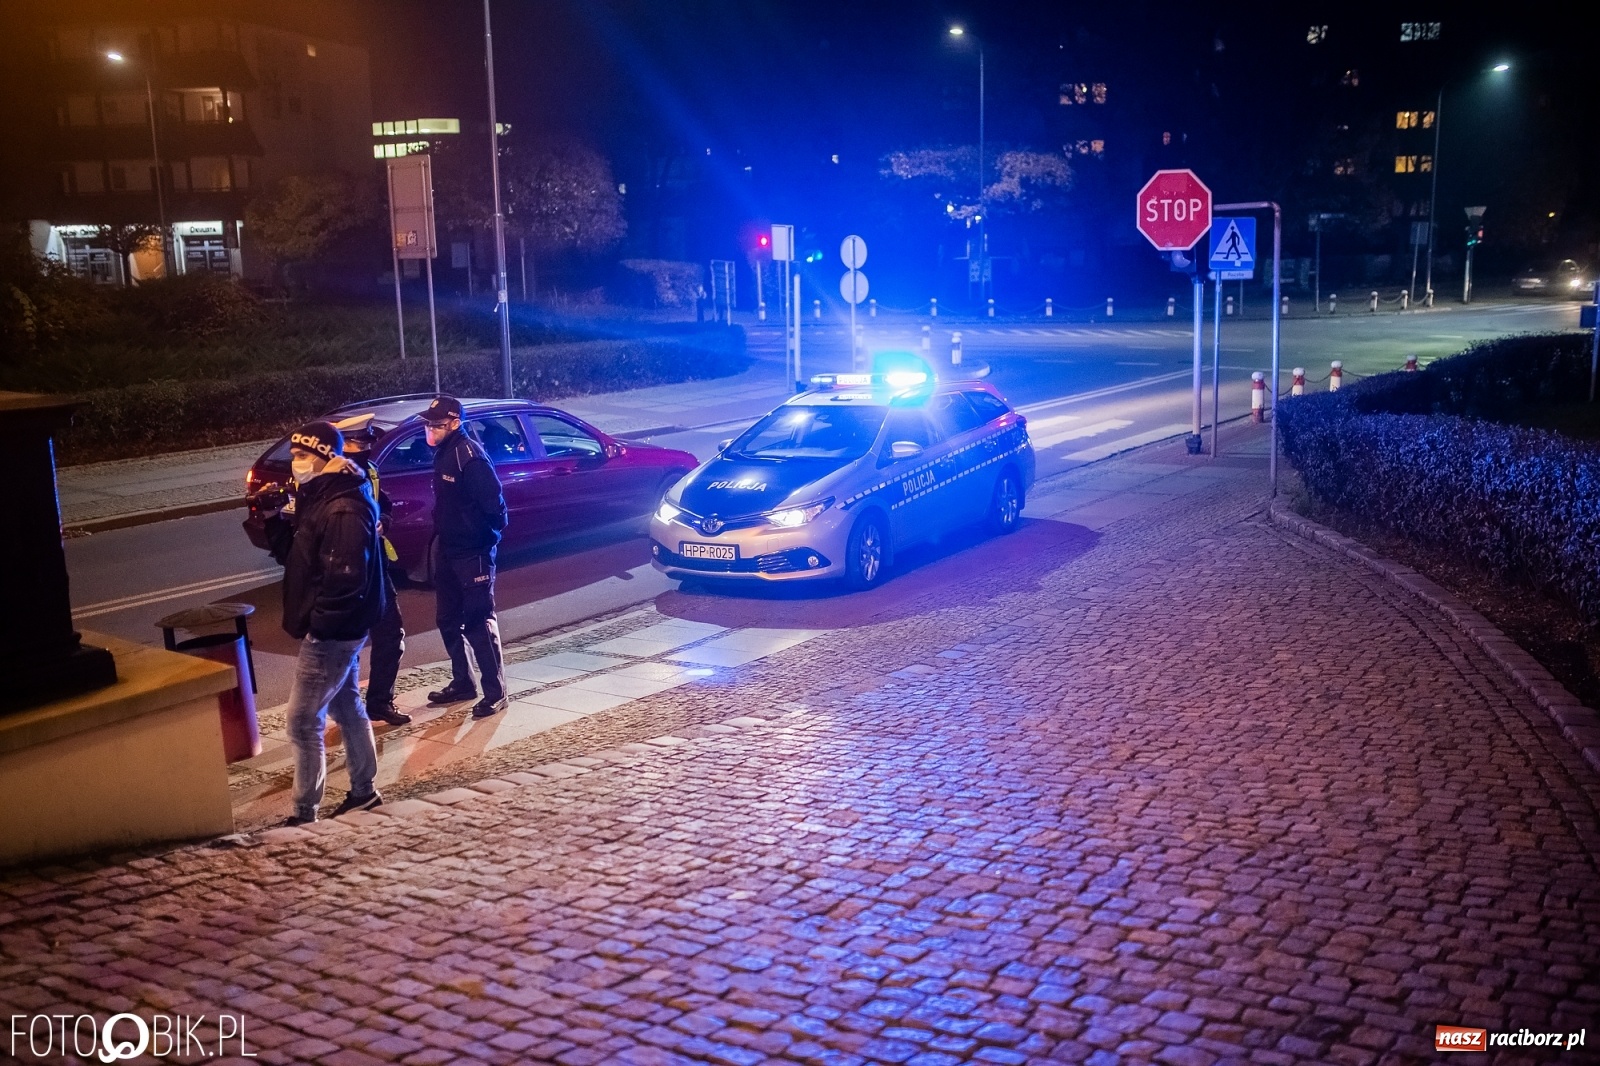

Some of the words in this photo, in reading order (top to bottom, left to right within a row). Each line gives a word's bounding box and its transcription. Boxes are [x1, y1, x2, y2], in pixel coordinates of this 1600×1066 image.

[1146, 198, 1202, 222] STOP
[706, 480, 768, 491] POLICJA
[902, 469, 936, 496] POLICJA
